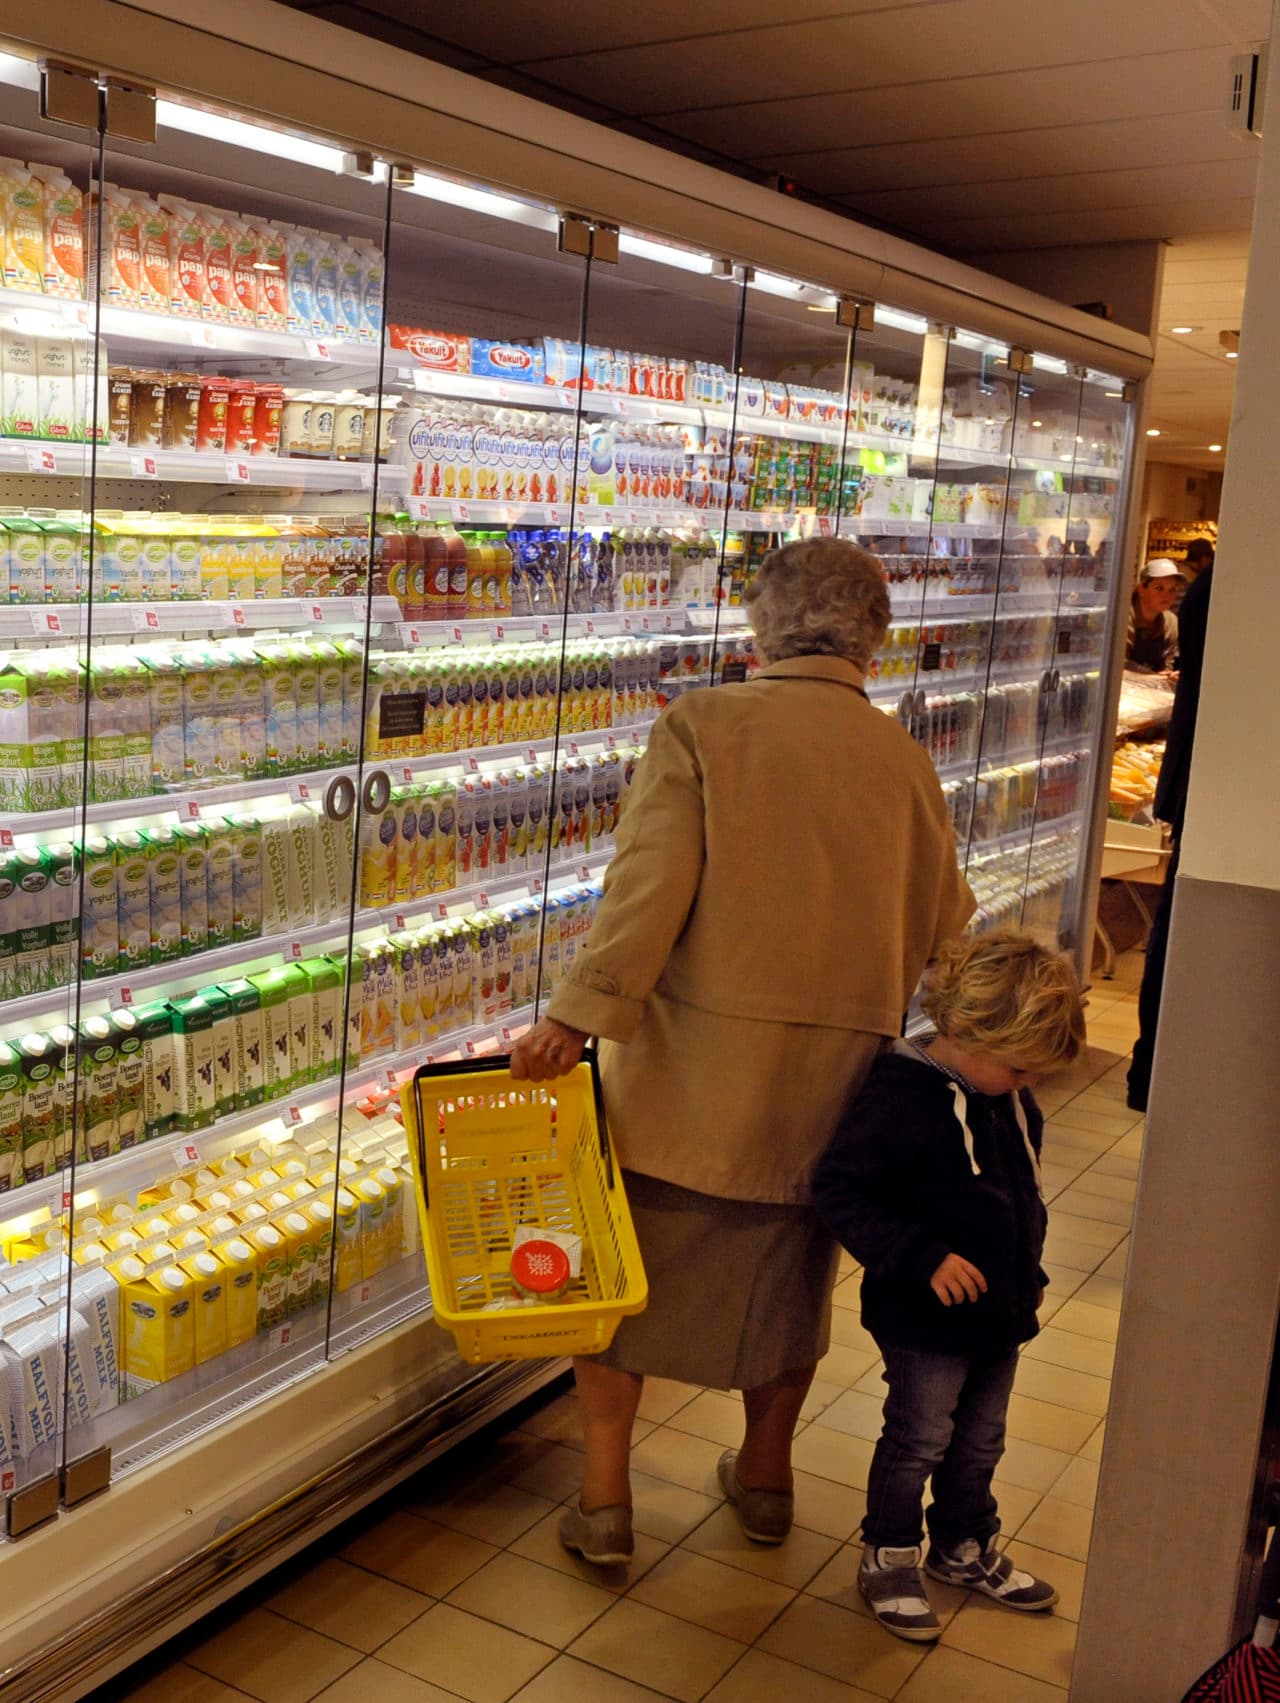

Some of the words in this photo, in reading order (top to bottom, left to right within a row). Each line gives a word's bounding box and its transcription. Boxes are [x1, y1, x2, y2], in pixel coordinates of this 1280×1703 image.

[14, 227, 43, 244] pap
[54, 232, 82, 250] pap
[117, 248, 139, 261] pap
[146, 254, 169, 268] pap
[180, 260, 204, 274] pap
[208, 267, 230, 279] pap
[235, 272, 257, 284] pap
[418, 342, 447, 356] Yakult
[497, 353, 525, 366] Yakult
[28, 1090, 53, 1102] Boeren
[96, 1296, 118, 1390] HALFVOLLE
[93, 1346, 107, 1386] MELK
